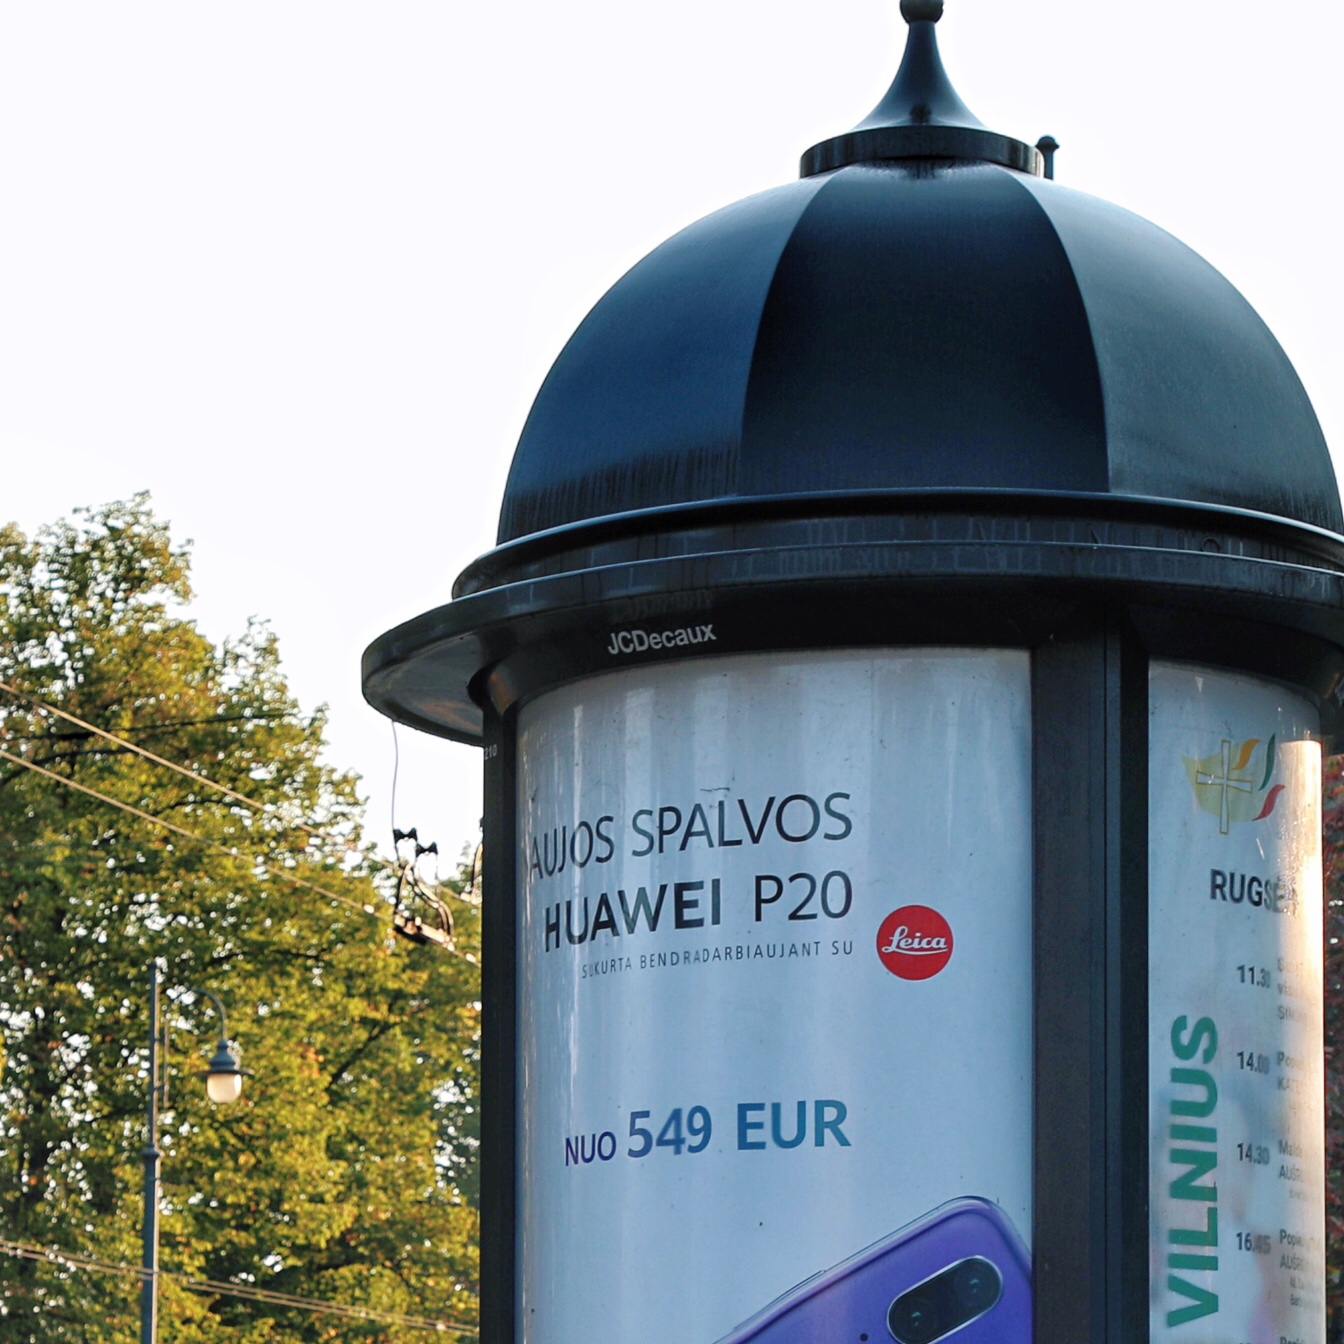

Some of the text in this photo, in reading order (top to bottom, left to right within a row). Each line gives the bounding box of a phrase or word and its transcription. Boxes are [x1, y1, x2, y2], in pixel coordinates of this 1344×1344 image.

[607, 624, 717, 655] JCDecaux
[632, 791, 853, 857] SPALVOS
[545, 870, 853, 953] HUAWEI P20
[581, 939, 854, 979] SUKURTA BENDRADARBIAUJANT SU
[881, 925, 949, 956] Leica
[564, 1099, 852, 1168] NUO 549 EUR
[1237, 1142, 1270, 1166] 14.30
[1166, 1014, 1218, 1328] VILNIUS
